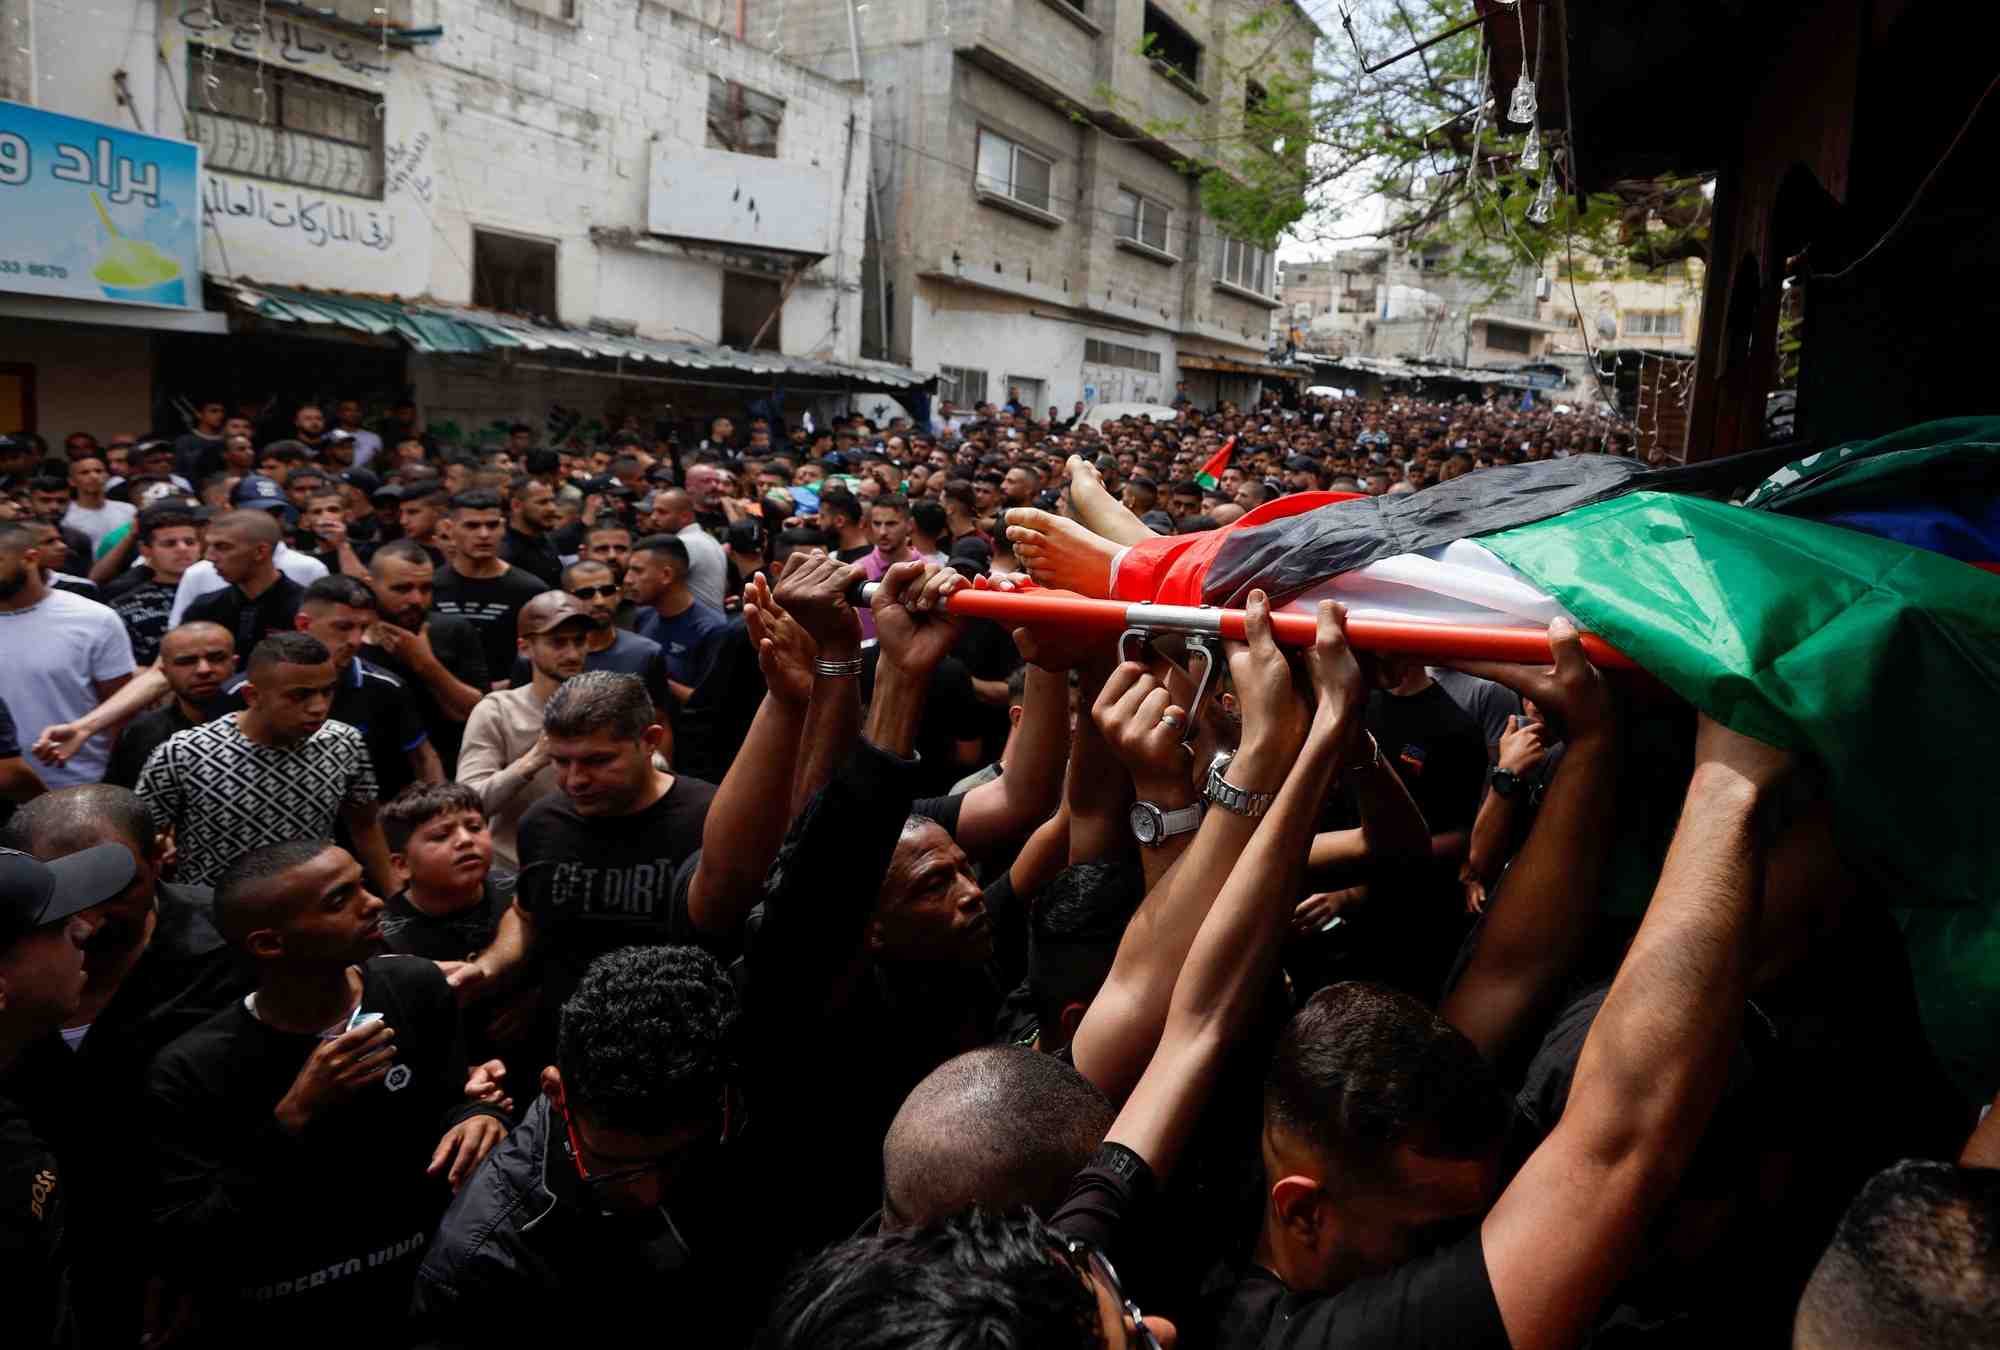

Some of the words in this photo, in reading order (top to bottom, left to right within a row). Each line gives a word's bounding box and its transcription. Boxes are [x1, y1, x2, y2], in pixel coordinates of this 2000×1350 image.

[53, 136, 161, 209] براد
[267, 193, 356, 247] الماركات
[552, 861, 599, 912] GET
